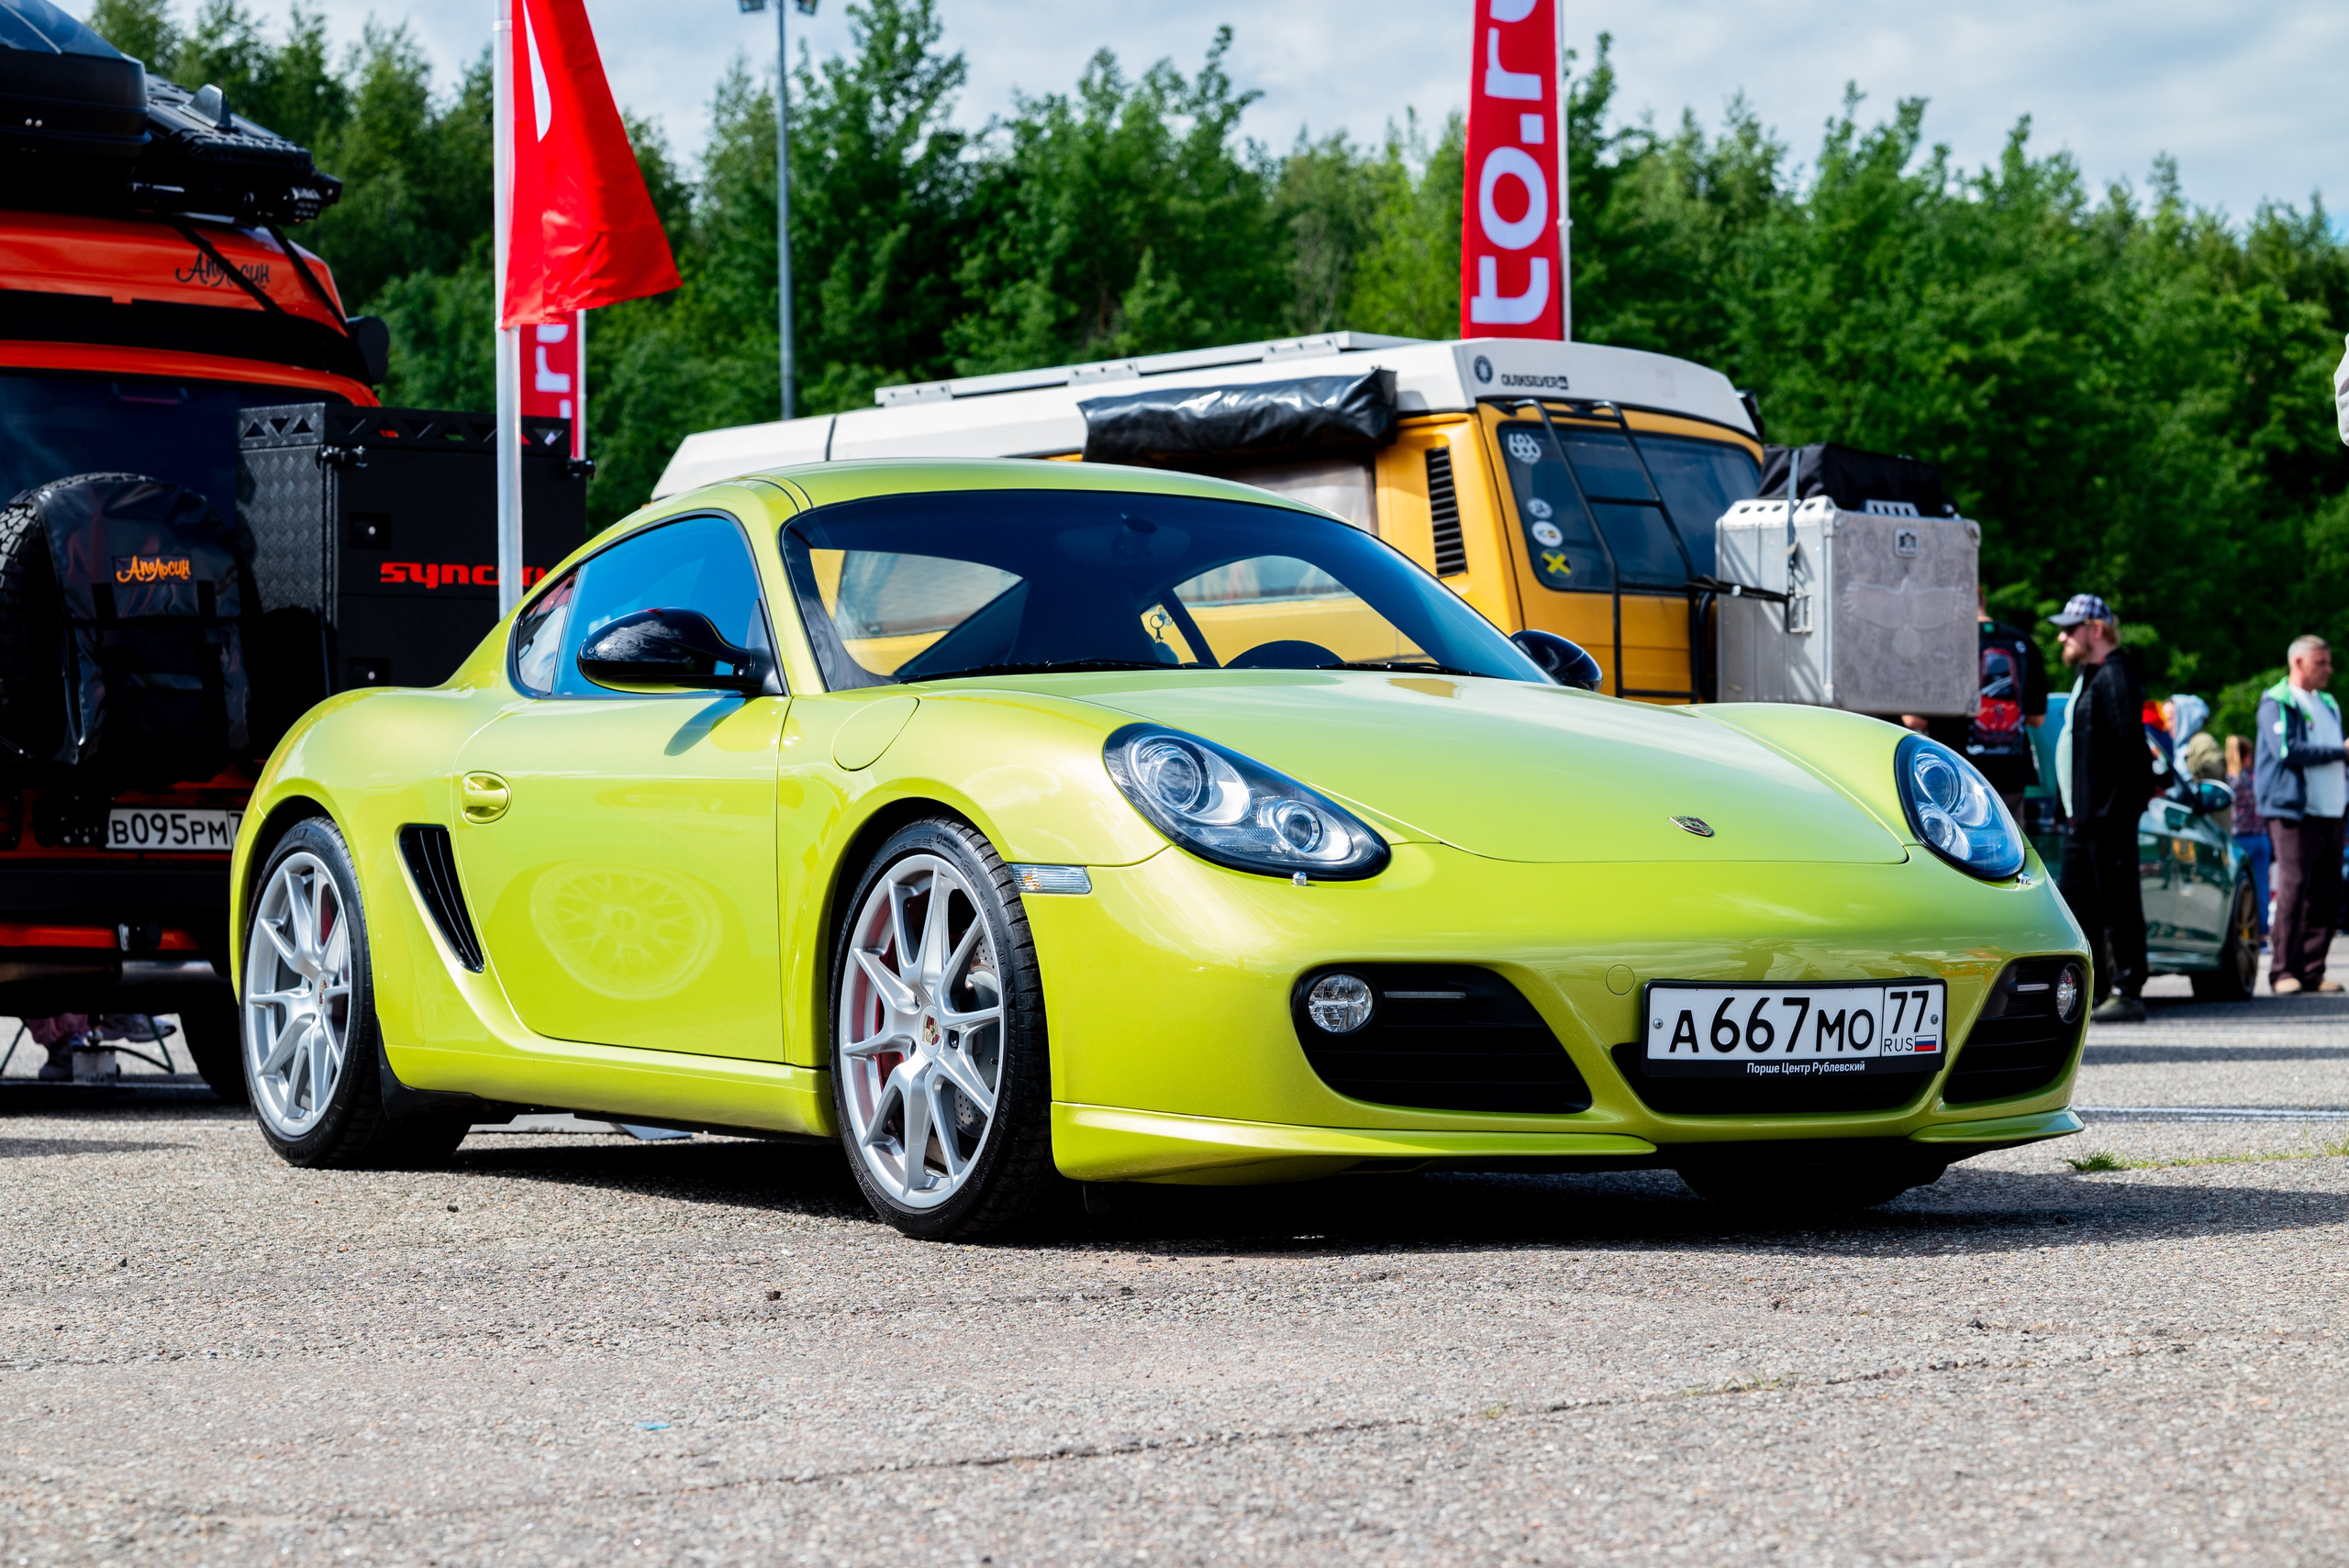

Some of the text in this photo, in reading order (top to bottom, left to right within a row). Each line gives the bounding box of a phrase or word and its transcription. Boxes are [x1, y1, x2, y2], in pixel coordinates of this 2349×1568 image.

[116, 555, 191, 583] Апельсин
[1889, 990, 1930, 1034] 77
[1884, 1037, 1914, 1052] RUS
[1747, 1061, 1865, 1075] Порше Центр Рублевский
